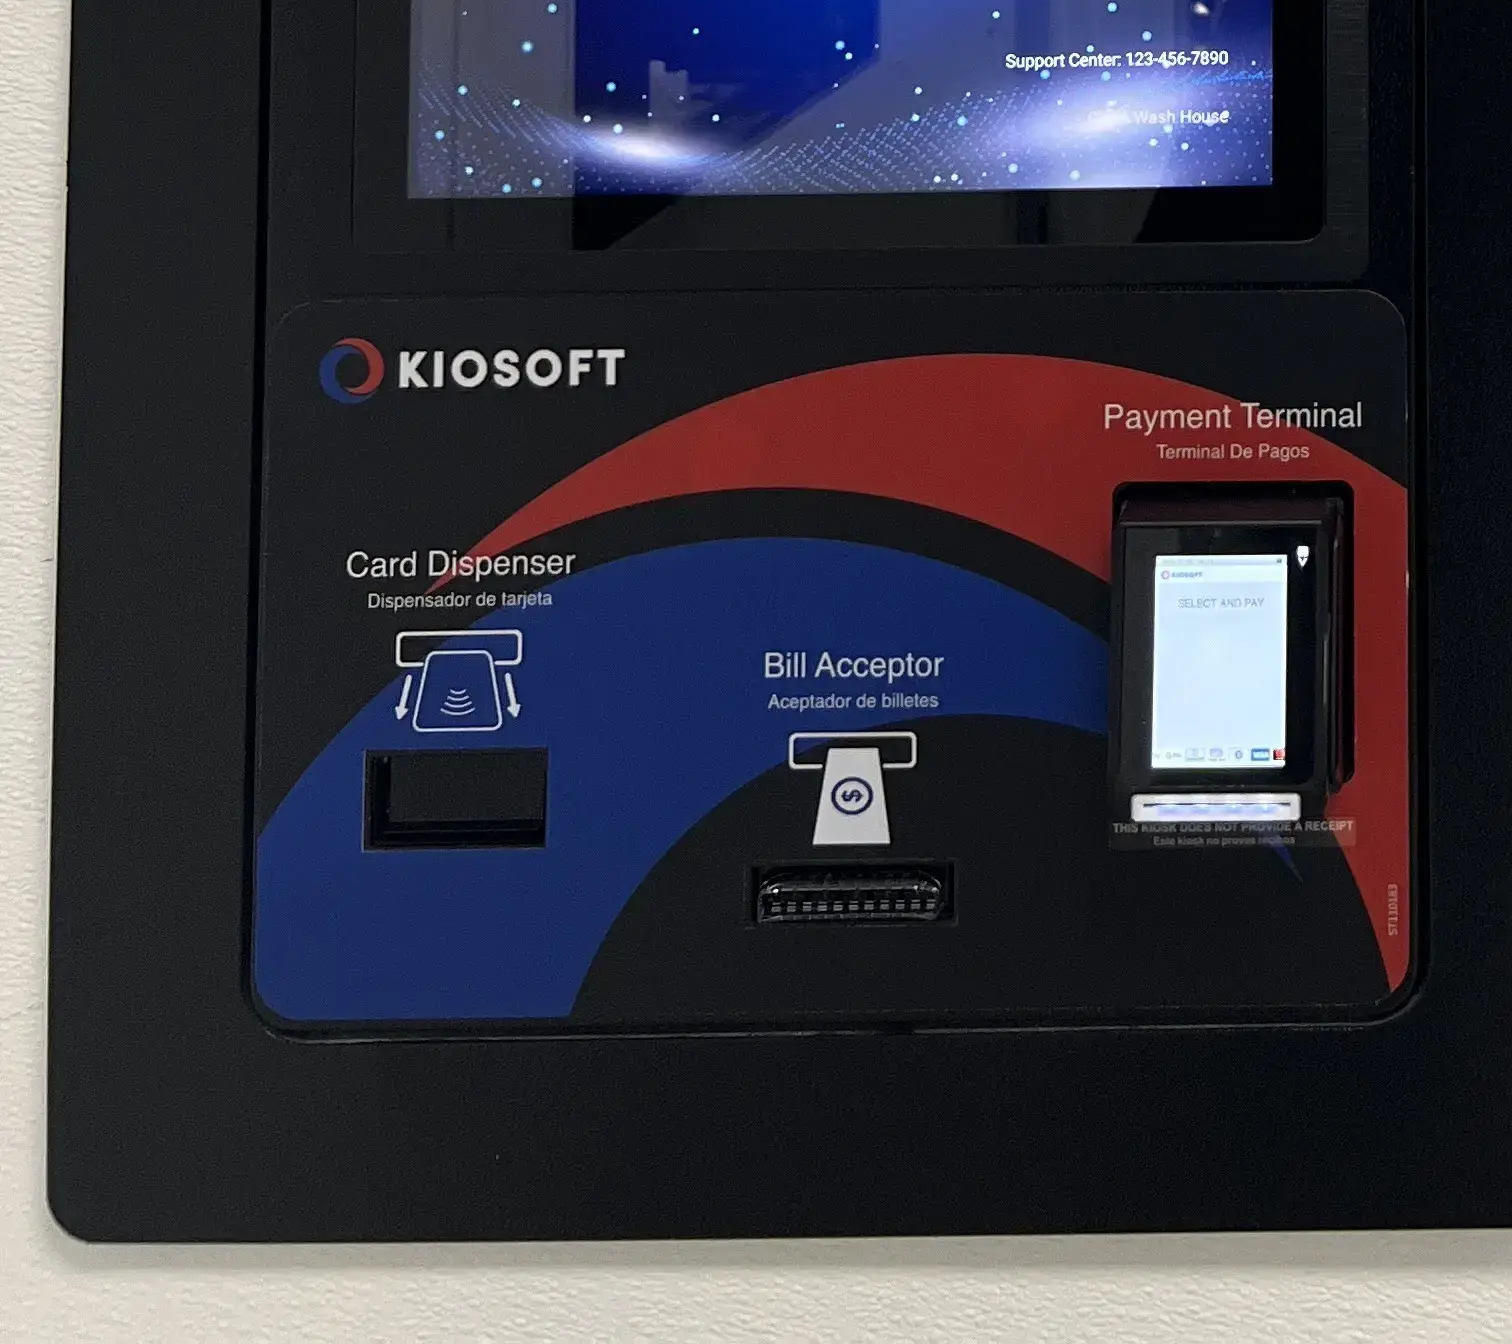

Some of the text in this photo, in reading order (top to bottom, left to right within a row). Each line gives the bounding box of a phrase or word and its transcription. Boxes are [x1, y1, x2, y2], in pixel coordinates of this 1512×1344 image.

[1005, 50, 1229, 71] Support Center: 123-456-7890
[1135, 110, 1176, 124] Wash
[1180, 109, 1230, 124] House
[398, 348, 626, 389] KIOSOFT
[1104, 402, 1363, 436] Payment Terminal
[1156, 443, 1310, 462] Terminal De Pagos
[347, 550, 576, 582] Card Dispenser
[367, 591, 552, 612] Dispensador de tarjeta
[1178, 598, 1265, 609] SELECT AND PAY
[764, 651, 945, 684] Bill Acceptor
[767, 692, 939, 712] Aceptador de billetes
[1113, 823, 1138, 832] THIS
[1180, 823, 1212, 832] DOES
[1214, 823, 1237, 832] NOT
[1241, 822, 1292, 832] PROVIDE
[1294, 822, 1303, 831] A
[1305, 821, 1354, 831] RECEIPT
